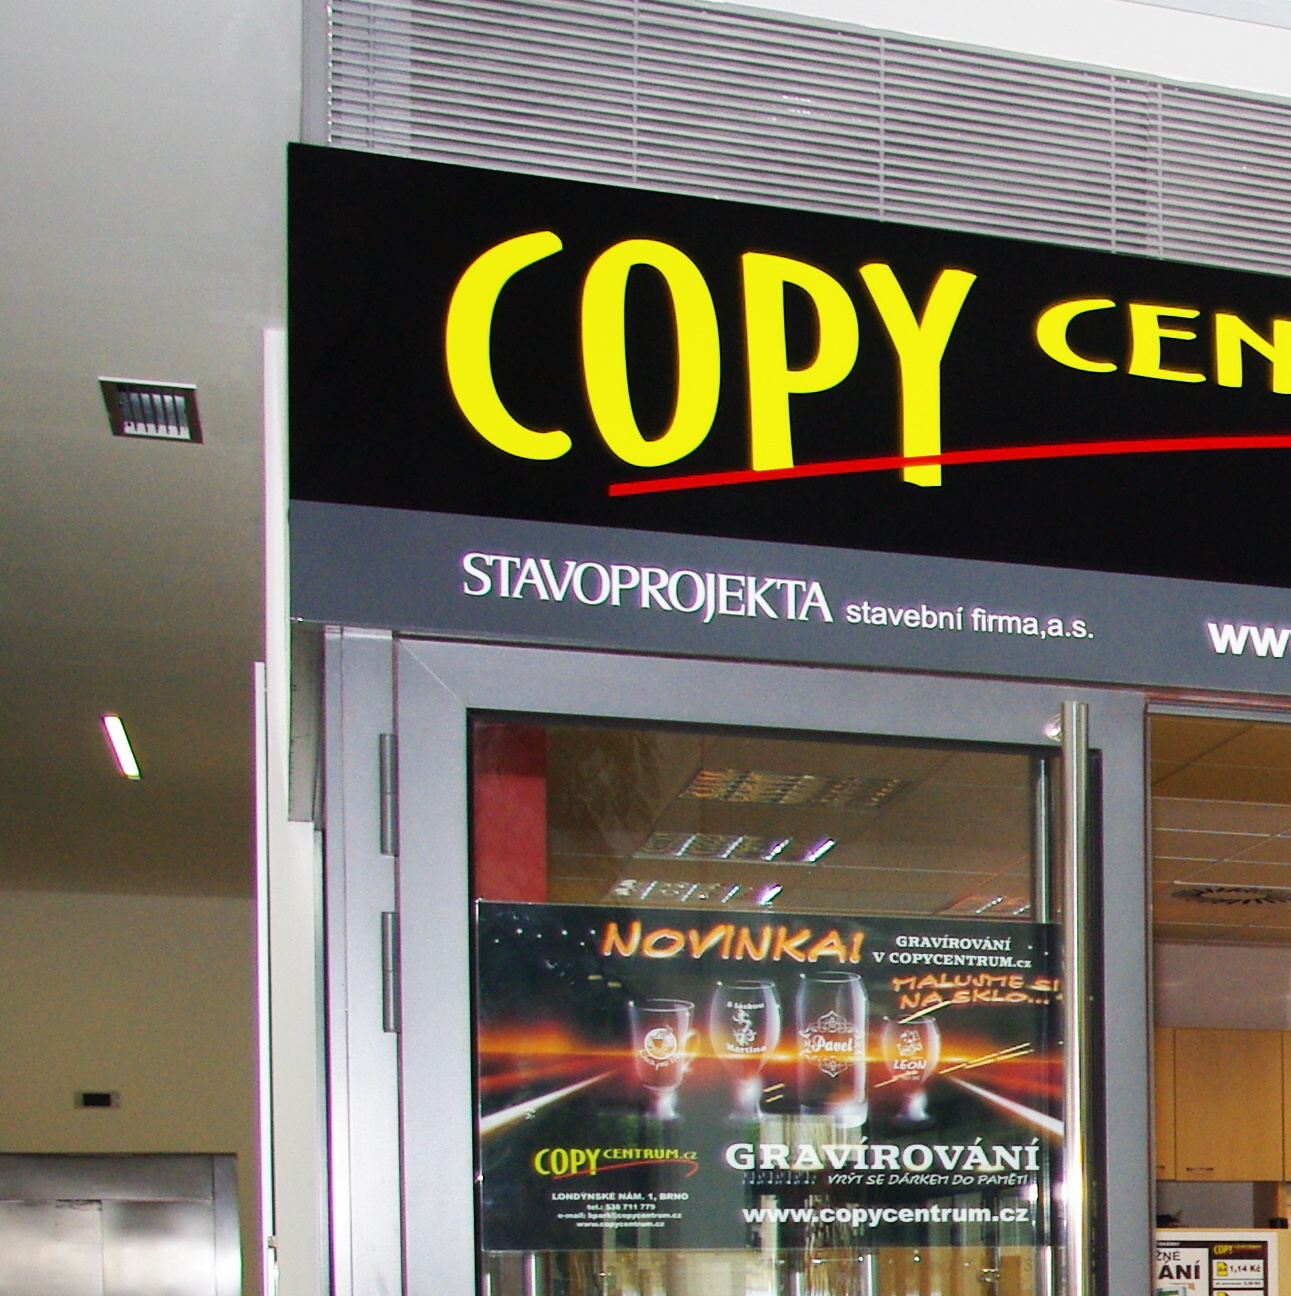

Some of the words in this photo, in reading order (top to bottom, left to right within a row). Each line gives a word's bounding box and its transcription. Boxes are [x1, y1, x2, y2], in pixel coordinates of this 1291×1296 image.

[445, 230, 977, 487] COPY
[462, 552, 833, 623] STAVOPROJEKTA
[845, 600, 964, 632] stavební
[970, 606, 1095, 640] firma,a.s.
[602, 920, 865, 965] NOVINKA!
[895, 933, 1012, 951] GRAVÍROVÁNÍ
[872, 951, 885, 964] V
[889, 952, 1032, 968] COPYCENTRUM.cz
[891, 972, 1025, 993] MALUJME
[812, 1035, 854, 1053] Pavel
[893, 1059, 928, 1070] LEON
[534, 1148, 602, 1176] COPY
[725, 1136, 1040, 1172] GRAVÍROVÁNÍ
[742, 1205, 1029, 1228] www.copycentrum.cz
